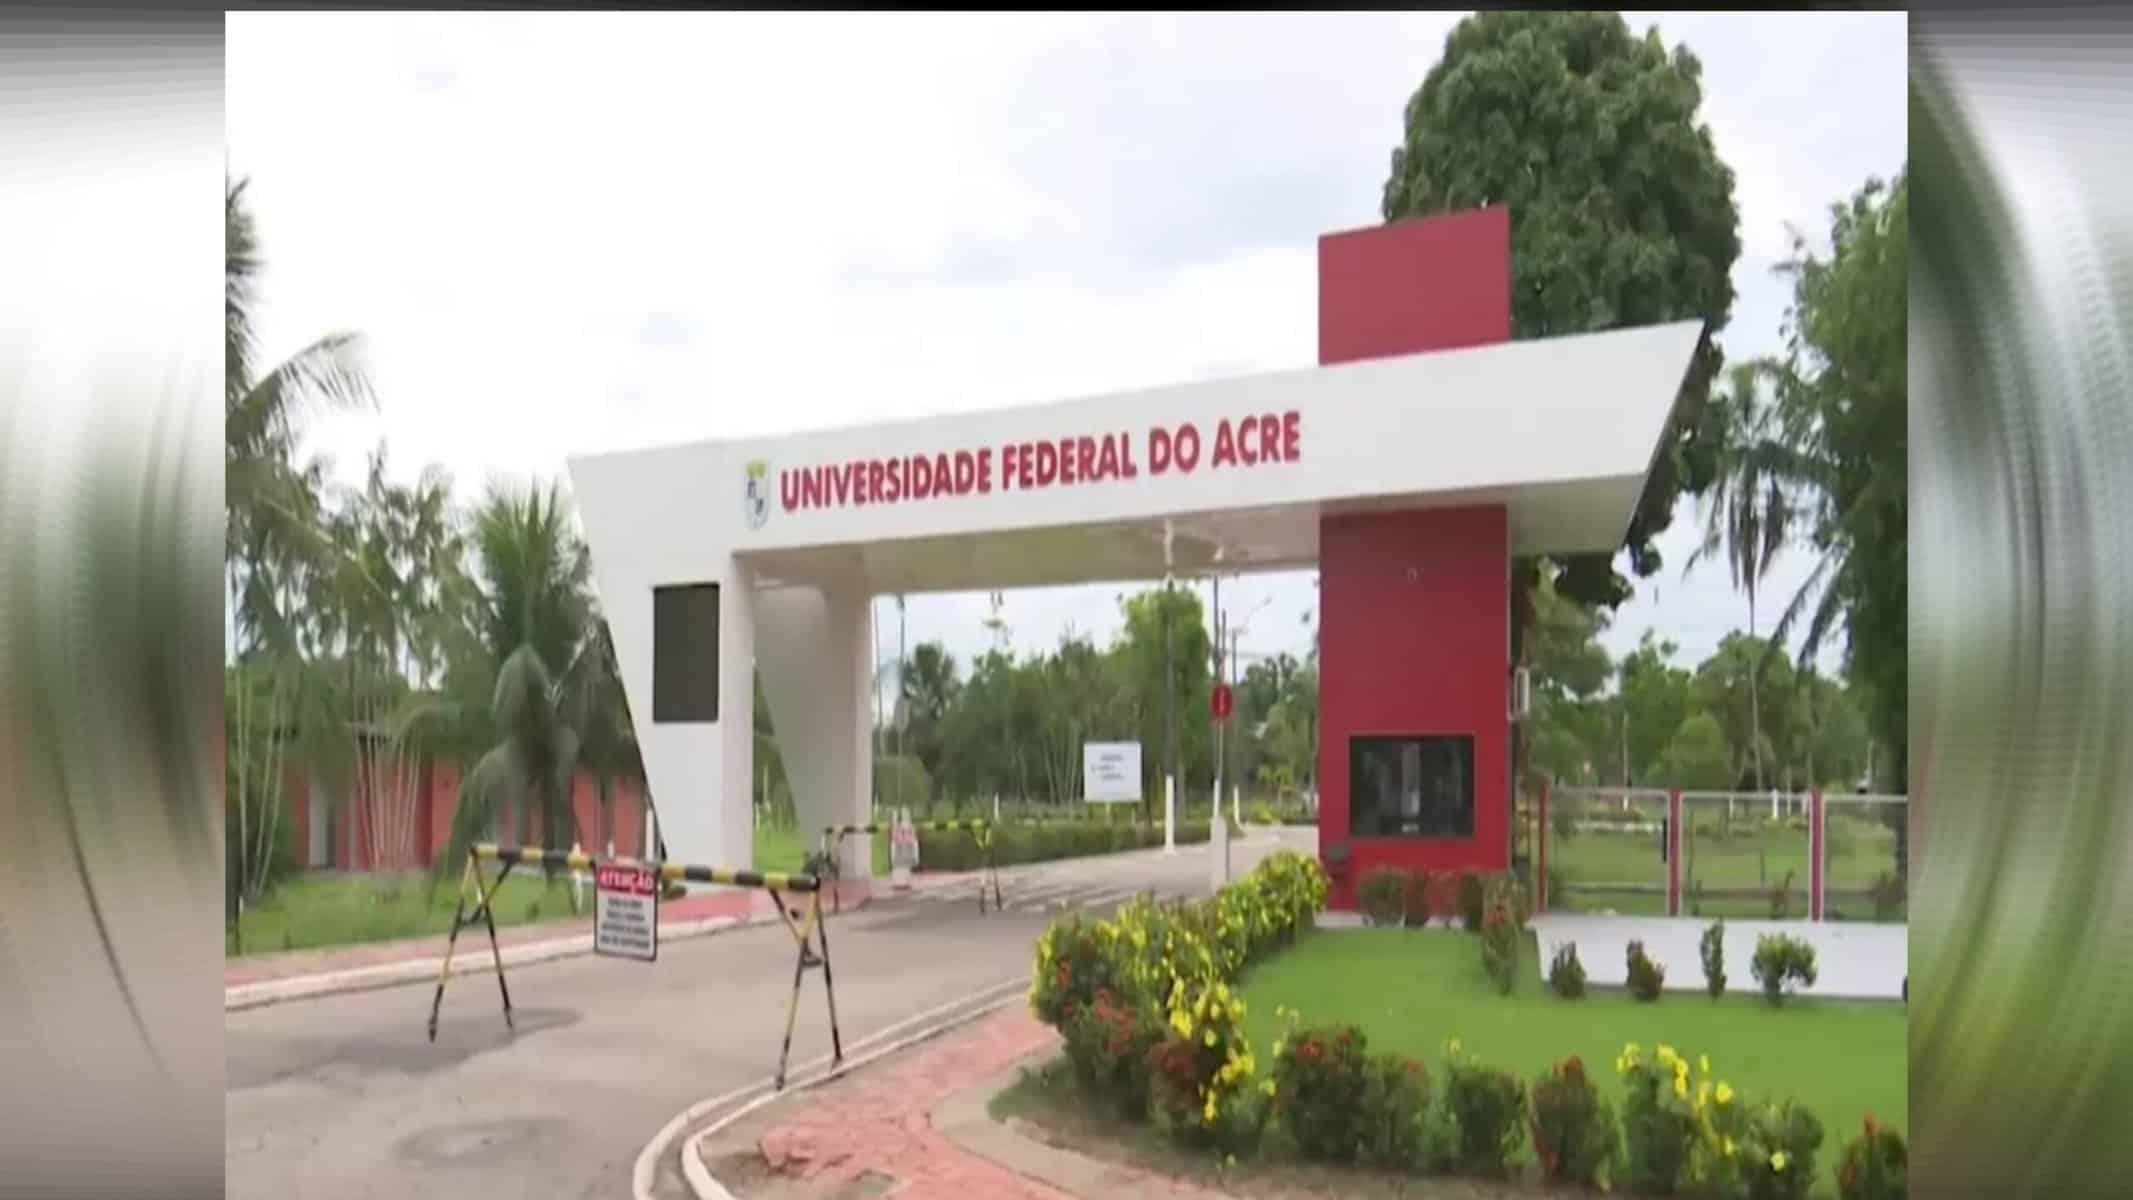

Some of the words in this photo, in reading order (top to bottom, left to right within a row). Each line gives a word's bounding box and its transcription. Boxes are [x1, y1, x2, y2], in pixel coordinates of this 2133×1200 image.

[781, 448, 992, 511] UNIVERSIDADE
[1000, 433, 1136, 490] FEDERAL
[1148, 423, 1201, 475] DO
[1212, 411, 1302, 467] ACRE
